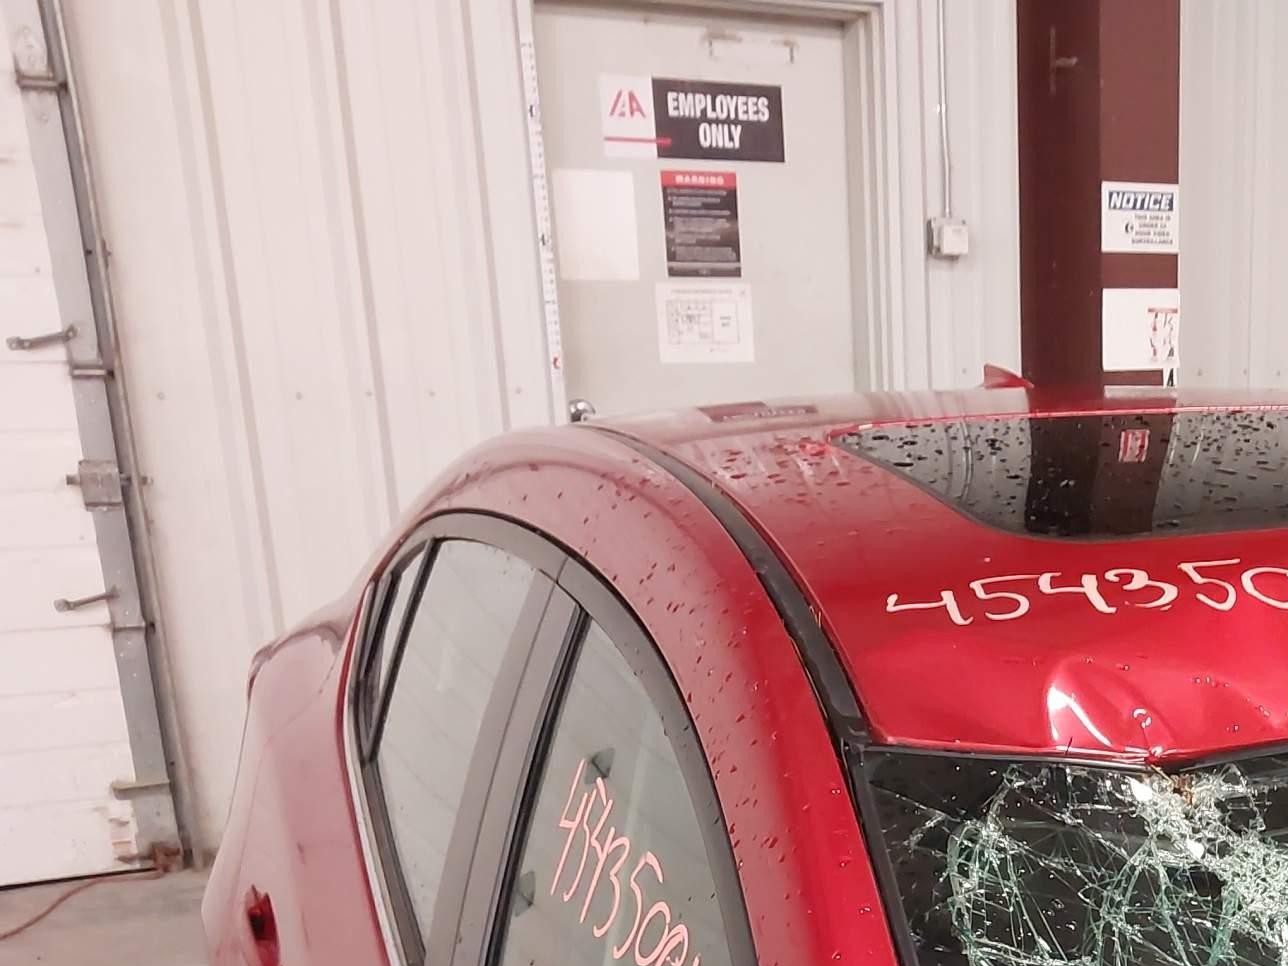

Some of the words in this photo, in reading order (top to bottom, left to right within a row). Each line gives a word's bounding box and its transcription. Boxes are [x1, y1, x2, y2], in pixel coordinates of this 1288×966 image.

[667, 91, 770, 122] EMPLOYEES
[698, 122, 743, 149] ONLY
[1110, 191, 1172, 209] NOTICE
